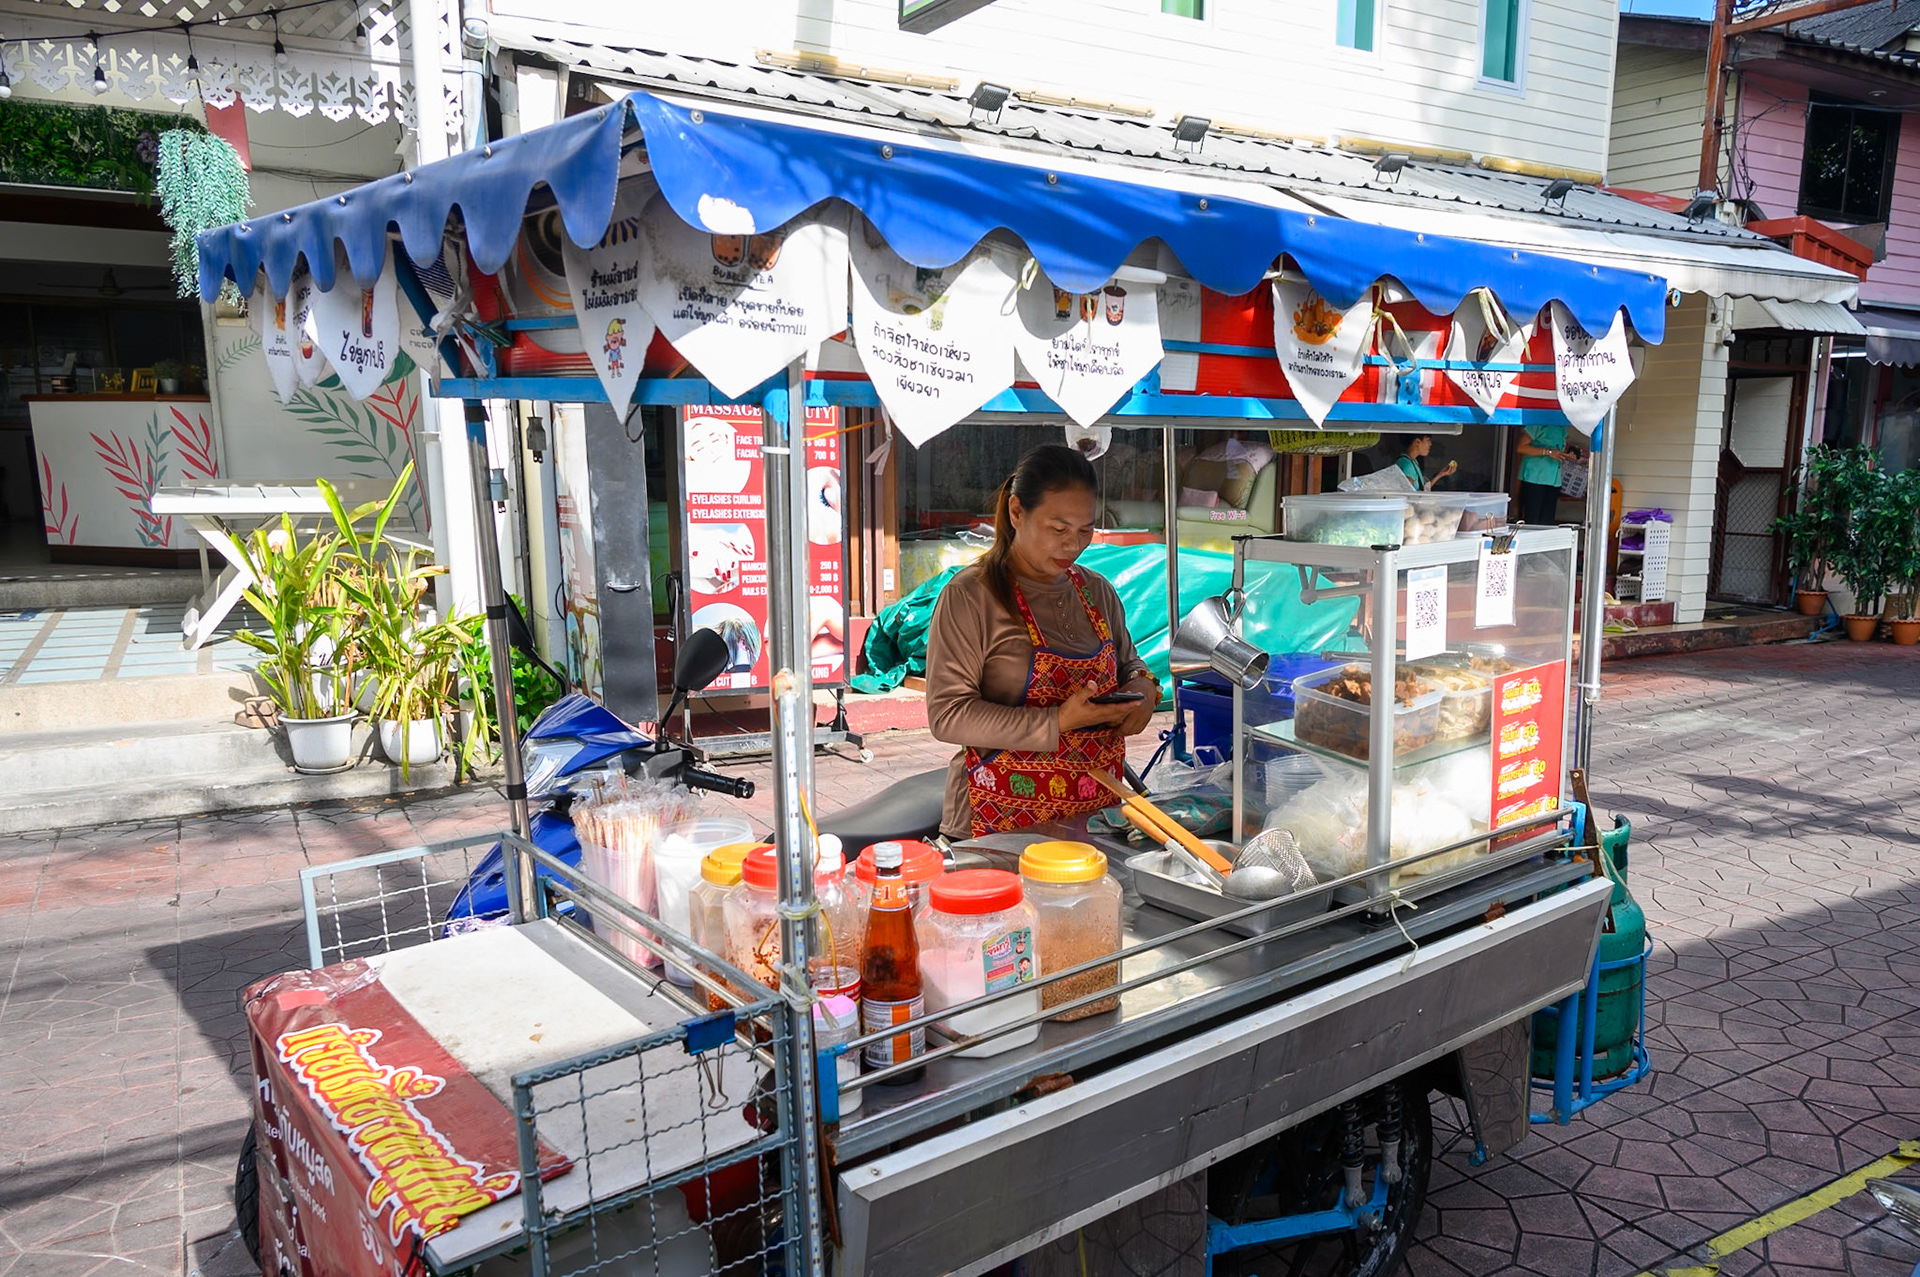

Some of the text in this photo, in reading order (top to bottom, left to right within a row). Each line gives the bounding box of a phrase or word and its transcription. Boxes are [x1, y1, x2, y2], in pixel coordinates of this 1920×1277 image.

[713, 265, 774, 285] BUBBLE TEA
[691, 404, 832, 419] MASSAGE UTY
[736, 435, 752, 445] FACE
[829, 438, 836, 447] B
[736, 449, 759, 459] FACIAL
[814, 451, 827, 460] 700
[830, 451, 836, 460] B
[692, 494, 762, 505] EYELASHES CURLING
[692, 508, 765, 519] EYELASHES EXTENSIO
[1210, 510, 1247, 521] Free Wi-Fi
[741, 562, 767, 571] MANICU
[832, 561, 839, 570] B
[741, 575, 767, 584] PEDICUR
[833, 573, 839, 582] B
[742, 587, 760, 596] NAILS
[833, 585, 839, 594] B
[716, 676, 731, 687] CUT
[751, 675, 758, 685] B
